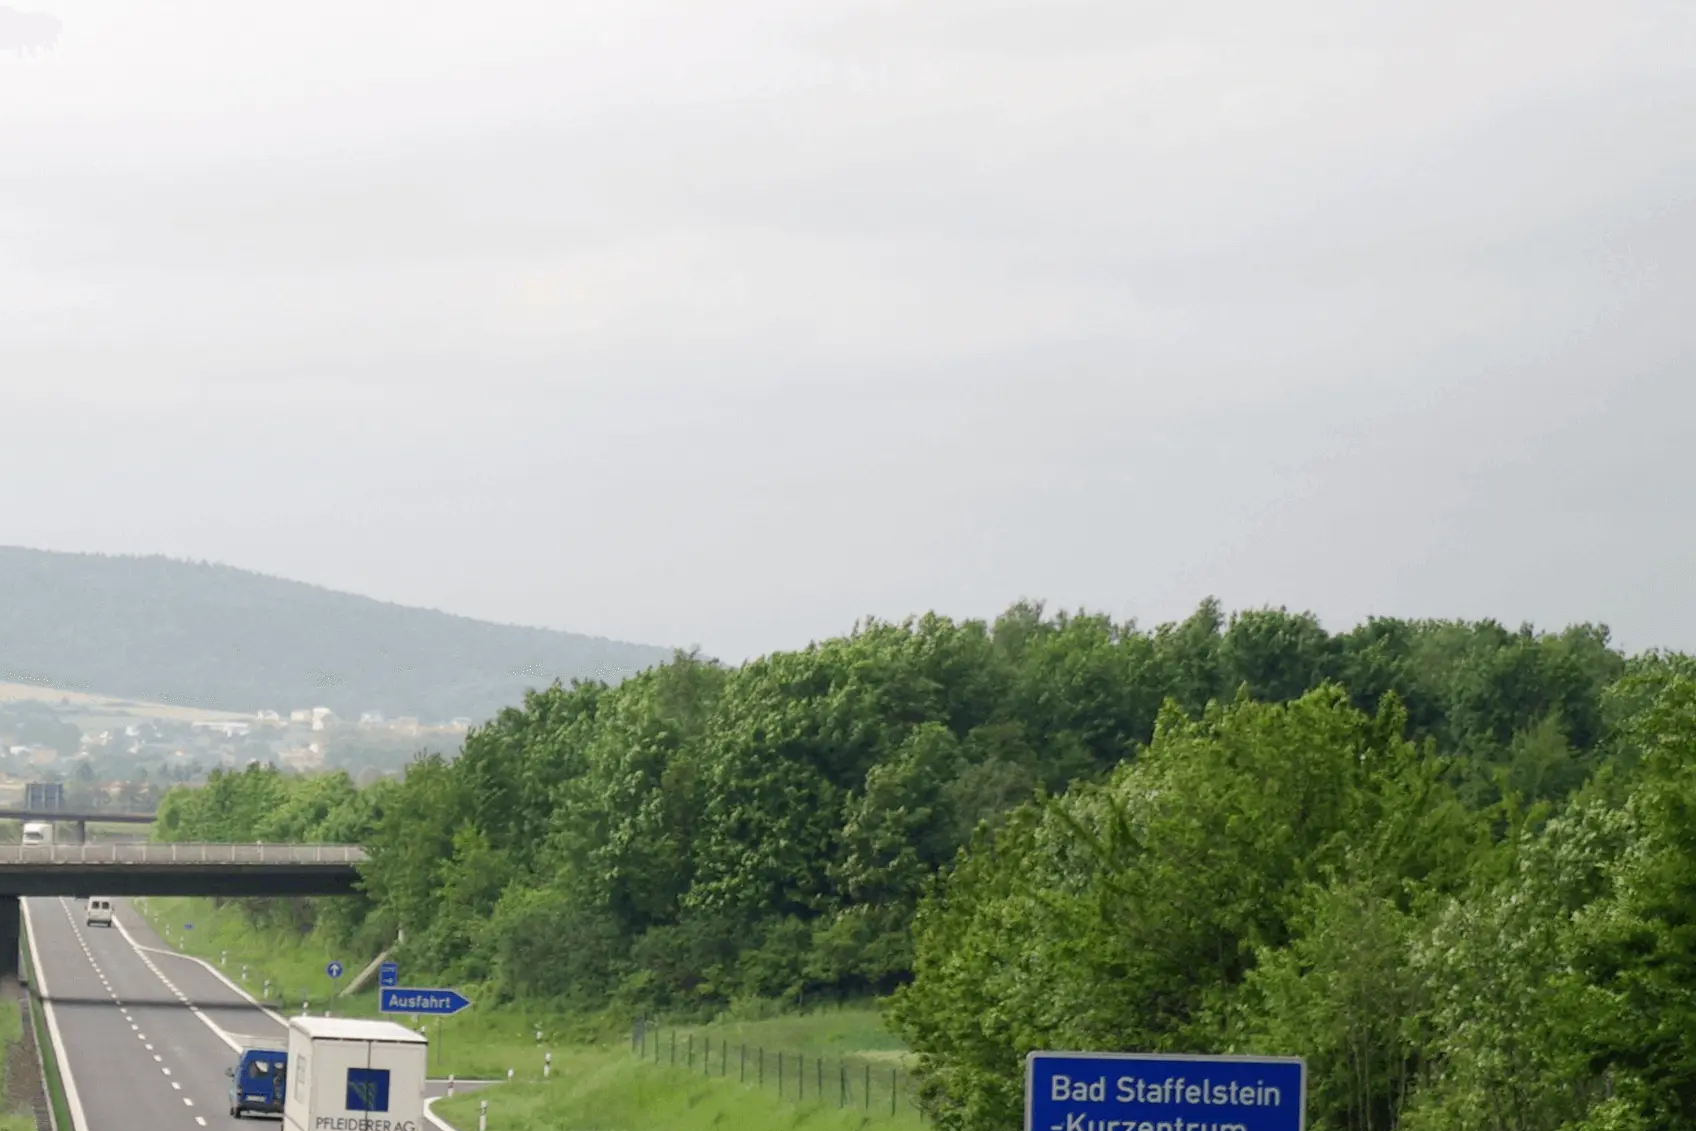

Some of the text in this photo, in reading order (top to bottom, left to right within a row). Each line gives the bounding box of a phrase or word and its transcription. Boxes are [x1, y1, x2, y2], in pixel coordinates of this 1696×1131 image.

[388, 994, 452, 1009] Ausfahrt
[1051, 1074, 1281, 1107] Bad Staffelstein
